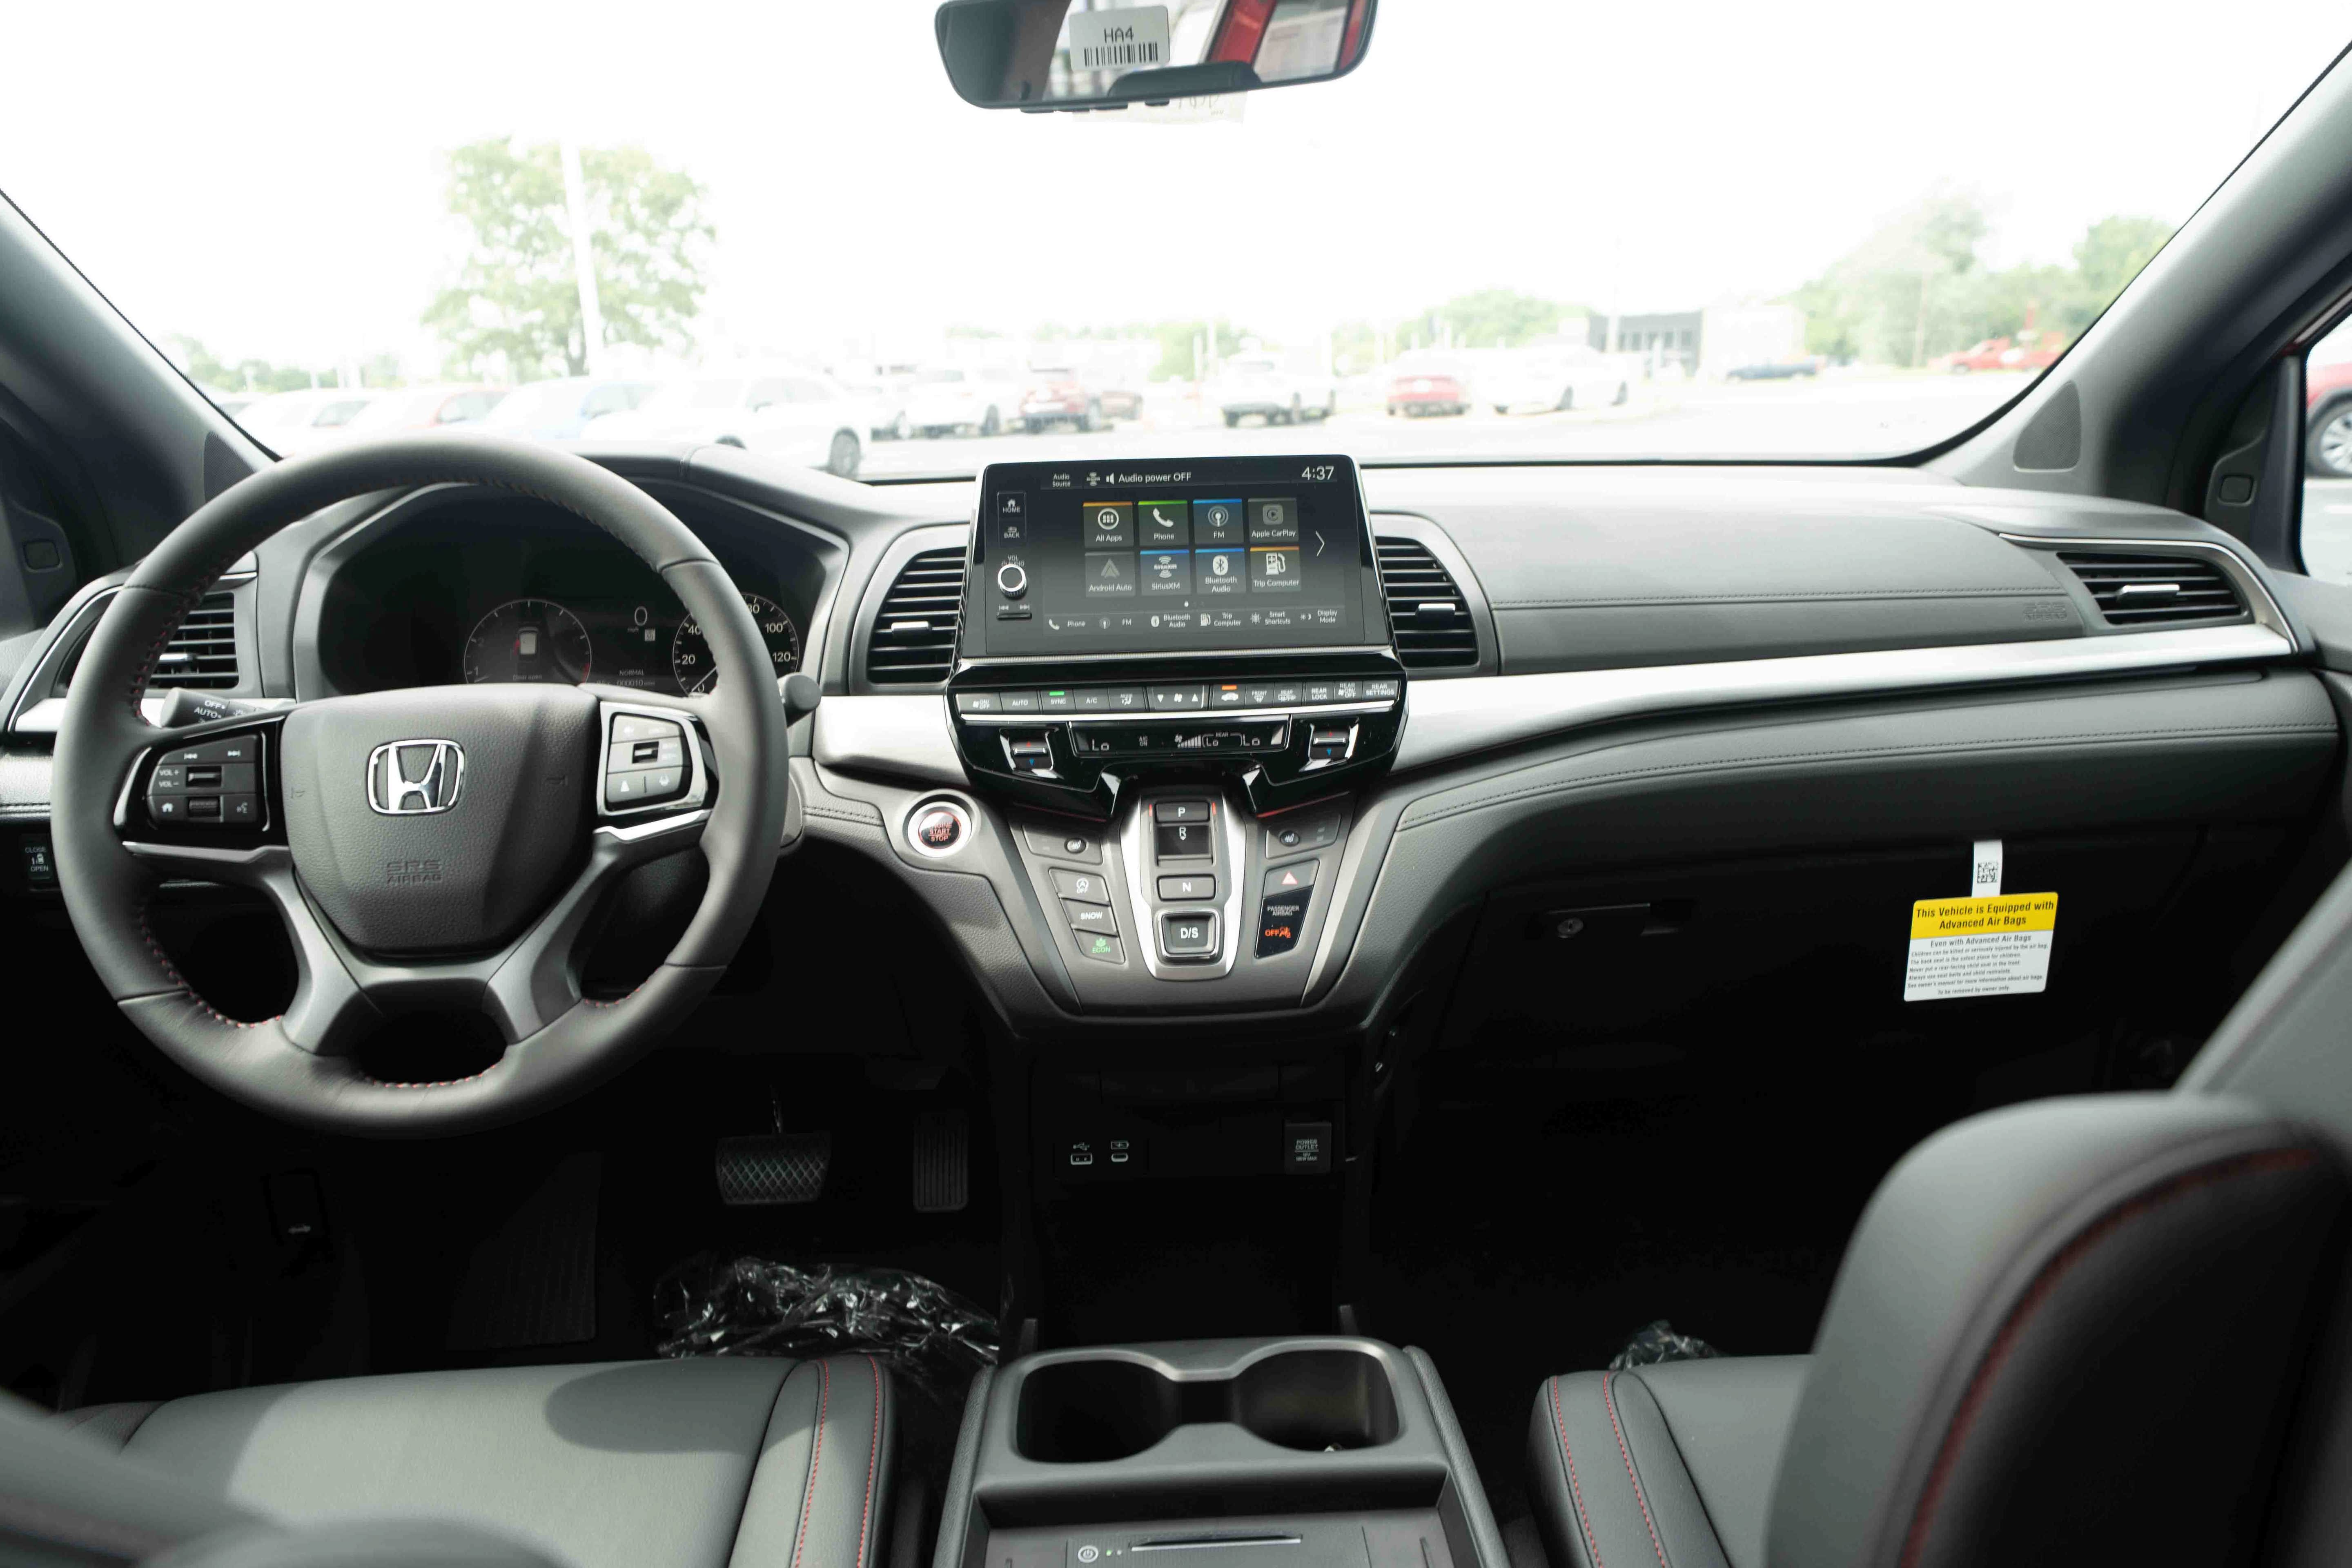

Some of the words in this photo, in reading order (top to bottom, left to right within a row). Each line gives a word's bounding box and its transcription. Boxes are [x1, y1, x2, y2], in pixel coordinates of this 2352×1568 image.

[1104, 25, 1134, 43] HA4
[1118, 473, 1143, 483] Audio
[1145, 474, 1171, 483] power
[1173, 472, 1192, 481] OFF
[1302, 466, 1334, 480] 4:37
[1106, 534, 1122, 543] Apps
[1251, 530, 1270, 538] Apple
[1272, 529, 1296, 538] CarPlay
[1205, 576, 1237, 584] Bluetooth
[1267, 579, 1299, 587] Computer
[1089, 584, 1114, 592] Android
[1152, 581, 1180, 590] SiriusXM
[635, 606, 647, 626] 0
[1317, 609, 1337, 617] Display
[688, 626, 701, 635] 40
[765, 624, 783, 633] 100
[682, 655, 695, 664] 20
[773, 652, 791, 662] 120
[205, 699, 222, 709] OFF
[194, 707, 218, 718] AUTO
[1092, 739, 1109, 751] Lo
[1243, 734, 1260, 746] Lo
[1178, 807, 1185, 817] P
[1179, 827, 1187, 836] R
[1182, 882, 1192, 892] N
[1917, 908, 1935, 918] This
[1939, 905, 1973, 918] Vehicle
[1976, 905, 1984, 914] is
[1987, 902, 2031, 914] Equipped
[2034, 901, 2054, 910] with
[1081, 911, 1102, 920] SNOW
[1939, 917, 1984, 930] Advanced
[1987, 916, 2001, 926] Air
[2003, 915, 2027, 927] Bags
[1180, 927, 1199, 939] D/S
[1966, 935, 2000, 945] Advanced
